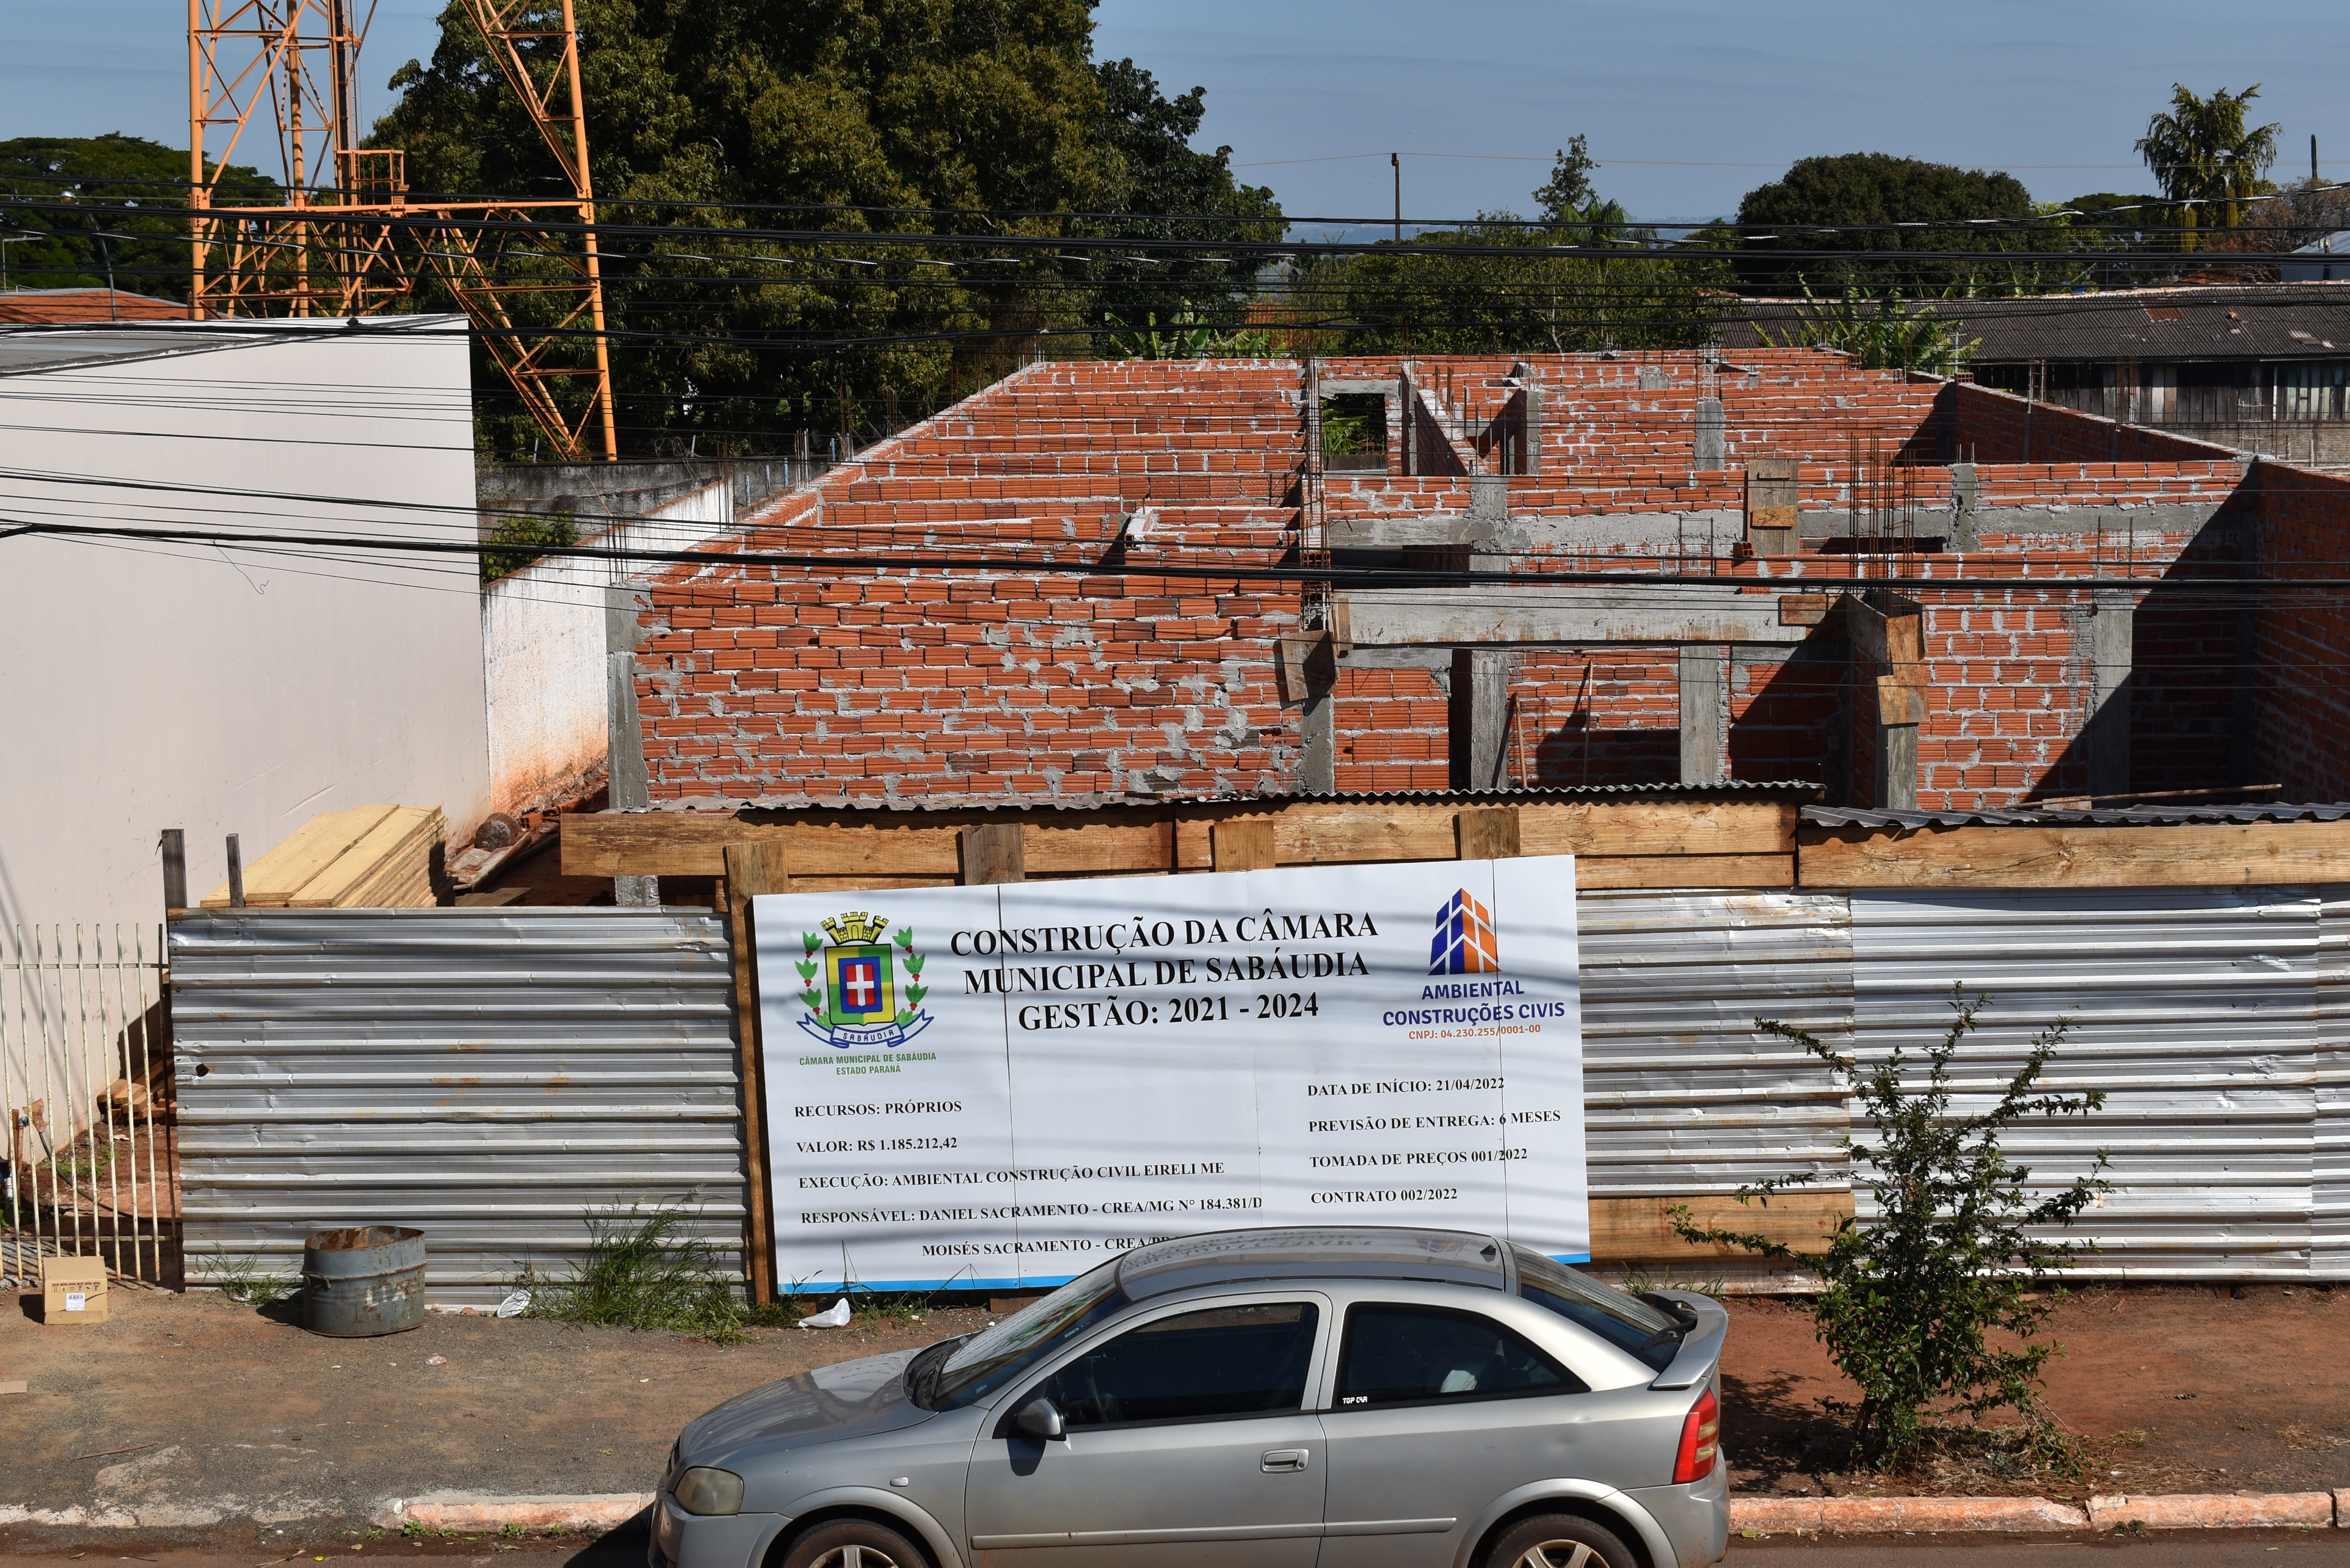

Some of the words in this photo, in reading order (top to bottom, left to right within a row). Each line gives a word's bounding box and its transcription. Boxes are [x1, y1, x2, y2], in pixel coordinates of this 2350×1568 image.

[950, 916, 1175, 956] CONSTRUÇÃO
[1182, 918, 1230, 945] DA
[1236, 907, 1379, 942] CÂMARA
[963, 962, 1146, 994] MUNICIPAL
[1154, 959, 1196, 985] DE
[1206, 947, 1370, 983] SABÁUDIA
[1422, 980, 1524, 999] AMBIENTAL
[1018, 993, 1158, 1031] GESTÃO:
[1168, 995, 1230, 1023] 2021
[1256, 991, 1319, 1019] 2024
[1383, 1002, 1514, 1025] CONSTRUÇÕES
[1518, 1002, 1565, 1019] CIVIS
[843, 1029, 894, 1041] SABÁUDIA
[1409, 1030, 1438, 1040] CNPJ:
[1441, 1024, 1540, 1037] 04.230.255/0001-00
[799, 1055, 834, 1066] CÂMARA
[836, 1054, 881, 1064] MUNICIPAL
[883, 1054, 894, 1062] DE
[896, 1052, 937, 1062] SABÁUDIA
[836, 1066, 867, 1075] ESTADO
[869, 1065, 901, 1074] PARANÁ
[1307, 1084, 1348, 1096] DATA
[1350, 1082, 1372, 1094] DE
[1376, 1078, 1431, 1093] INÍCIO:
[1436, 1077, 1504, 1091] 21/04/2022
[794, 1103, 880, 1117] RECURSOS:
[885, 1099, 962, 1114] PRÓPRIOS
[1308, 1116, 1387, 1132] PREVISÃO
[1390, 1117, 1411, 1129] DE
[1415, 1115, 1494, 1128] ENTREGA:
[1499, 1112, 1506, 1125] 6
[1511, 1110, 1561, 1124] MESES
[796, 1140, 853, 1153] VALOR:
[857, 1139, 876, 1151] R$
[879, 1137, 958, 1151] 1.185.212,42
[1309, 1155, 1378, 1168] TOMADA
[1381, 1154, 1402, 1165] DE
[1406, 1151, 1467, 1166] PREÇOS
[1471, 1148, 1528, 1161] 001/2022
[799, 1173, 888, 1190] EXECUÇÃO:
[892, 1172, 983, 1186] AMBIENTAL
[986, 1165, 1093, 1182] CONSTRUÇÃO
[1097, 1166, 1141, 1178] CIVIL
[1143, 1163, 1196, 1176] EIRELI
[1200, 1162, 1225, 1174] ME
[1311, 1190, 1397, 1204] CONTRATO
[1400, 1188, 1457, 1201] 002/2022
[800, 1207, 915, 1224] RESPONSÁVEL:
[919, 1208, 977, 1221] DANIEL
[981, 1203, 1089, 1219] SACRAMENTO
[1101, 1200, 1174, 1214] CREA/MG
[1200, 1197, 1262, 1210] 184.381/D
[922, 1241, 980, 1256] MOISÉS
[984, 1239, 1091, 1255] SACRAMENTO
